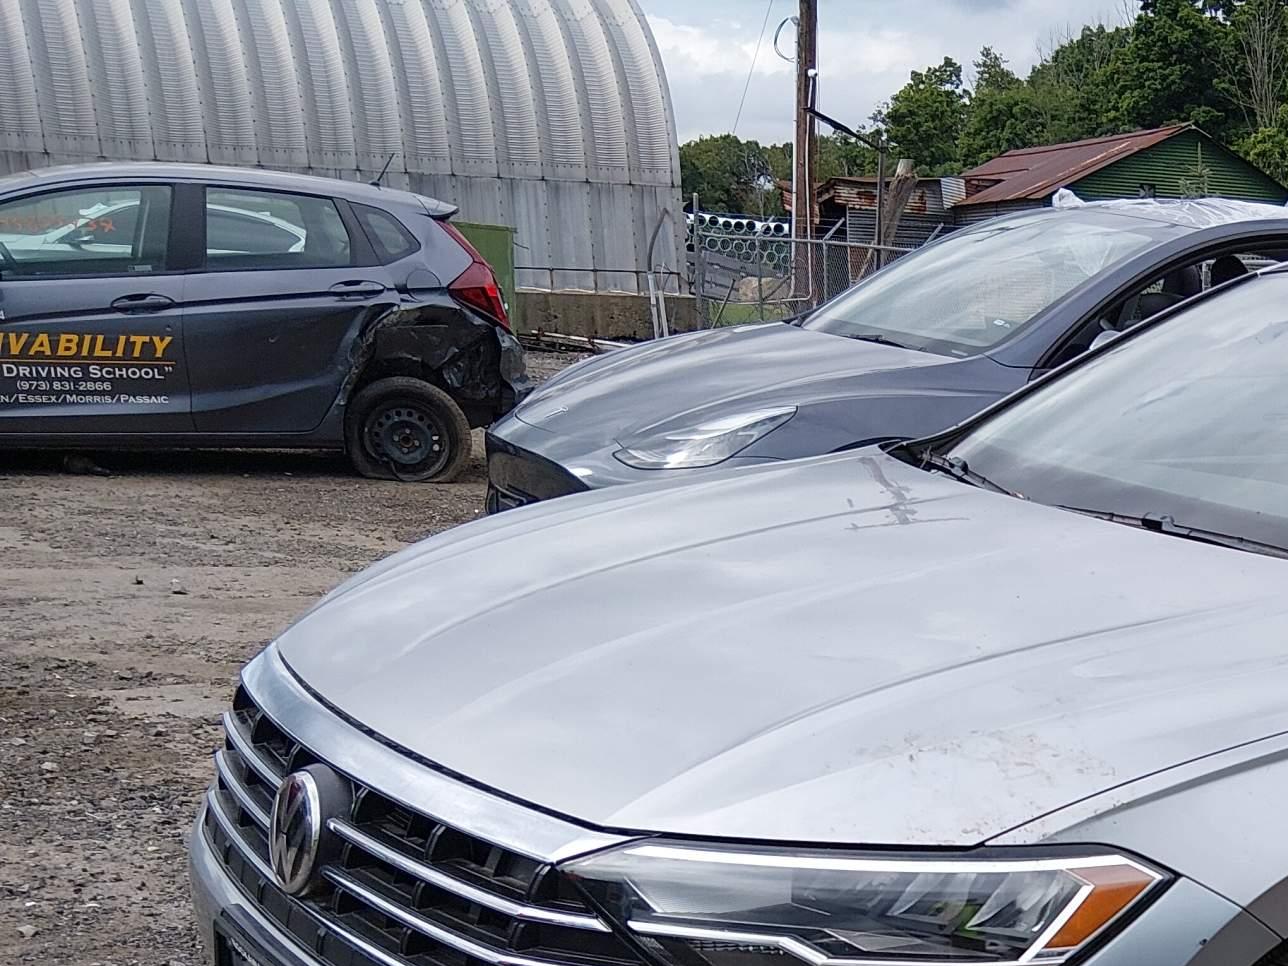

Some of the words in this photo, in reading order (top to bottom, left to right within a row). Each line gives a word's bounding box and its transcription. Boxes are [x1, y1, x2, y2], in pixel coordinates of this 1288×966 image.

[3, 364, 83, 378] DRIVING
[16, 380, 50, 391] (973)
[53, 381, 112, 391] 831-2866
